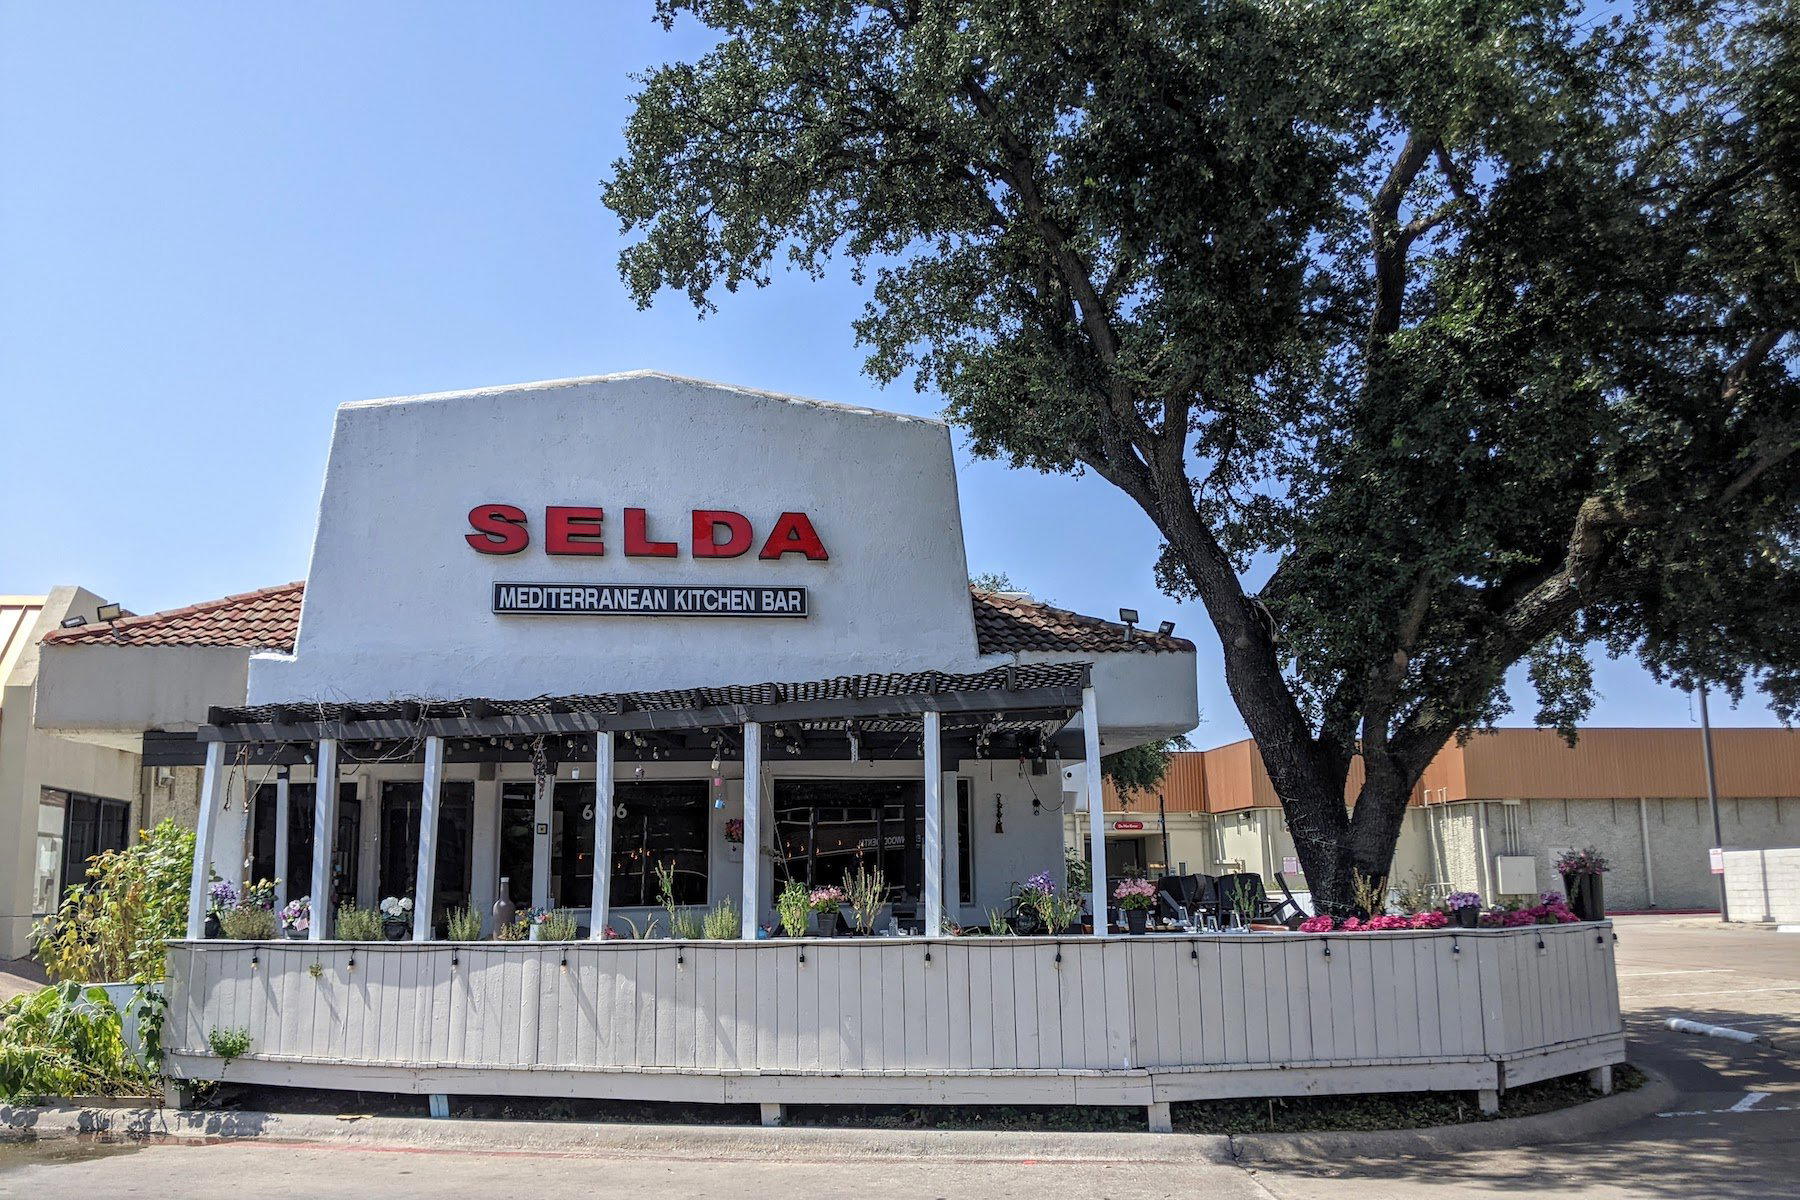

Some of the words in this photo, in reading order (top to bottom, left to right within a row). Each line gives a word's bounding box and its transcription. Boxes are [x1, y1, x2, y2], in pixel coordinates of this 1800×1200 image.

[465, 503, 829, 561] SELDA
[499, 586, 668, 610] MEDITERRANEAN
[674, 589, 755, 611] KITCHEN
[761, 590, 801, 612] BAR
